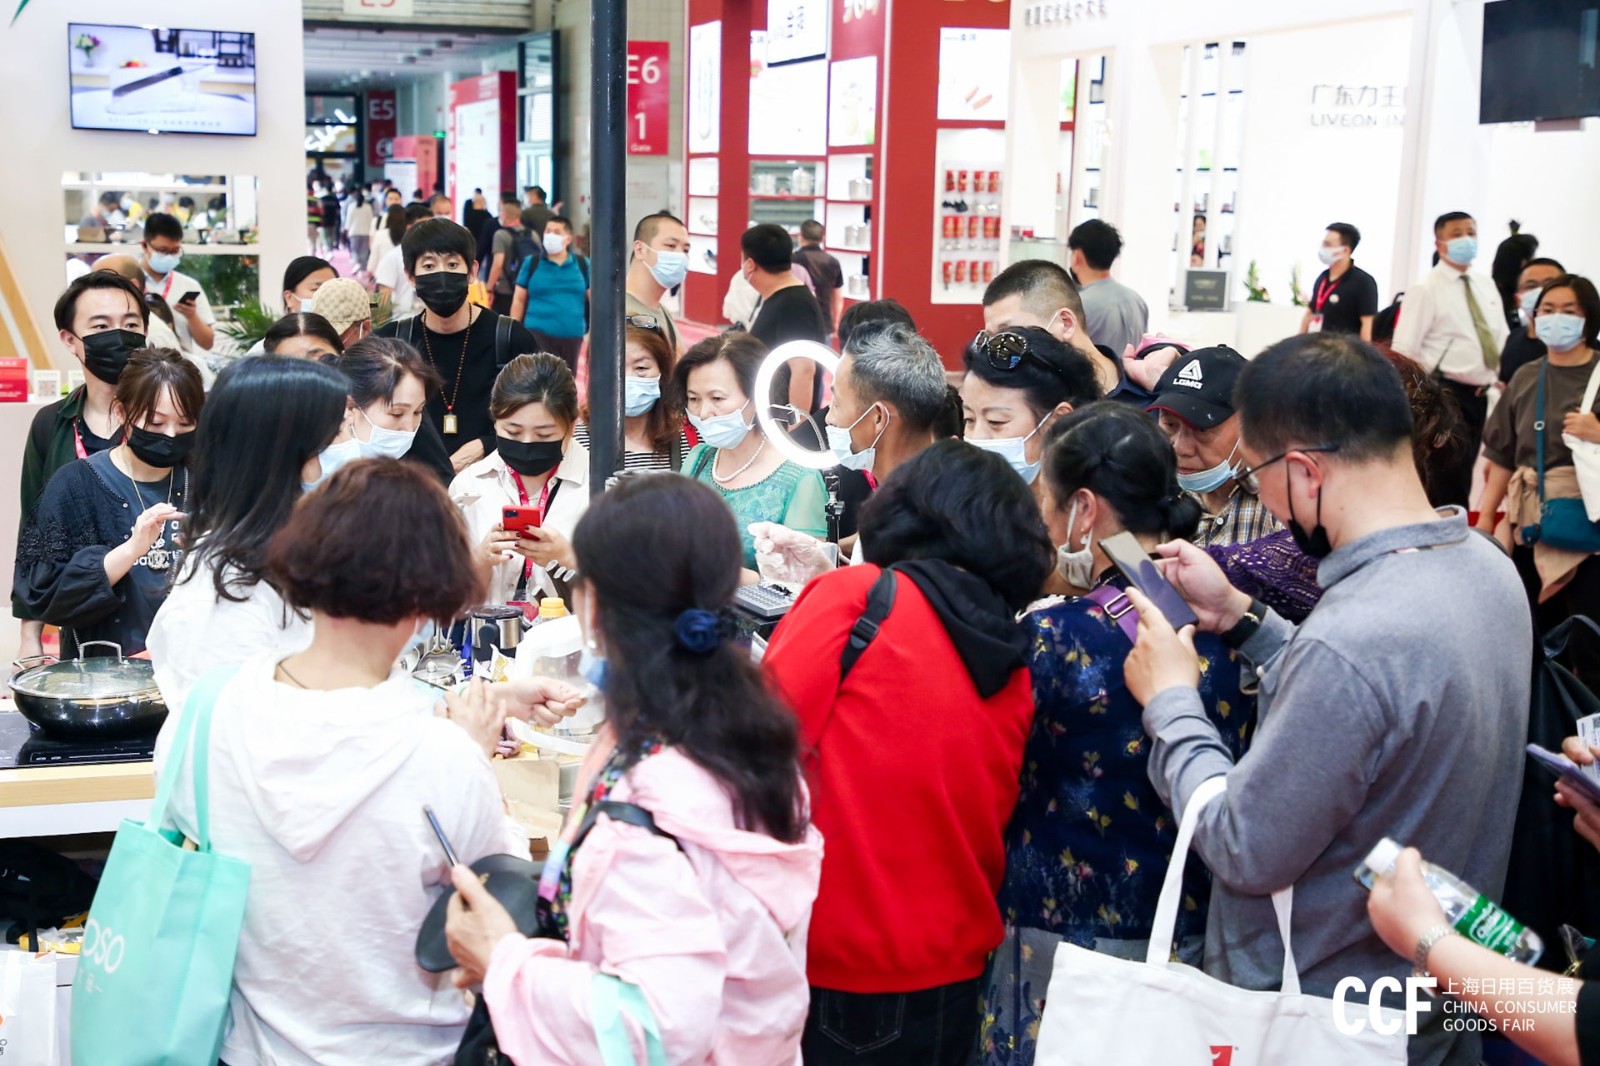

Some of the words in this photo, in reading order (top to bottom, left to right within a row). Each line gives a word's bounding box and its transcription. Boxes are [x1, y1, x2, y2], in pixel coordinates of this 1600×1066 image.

[627, 54, 661, 85] E6
[1311, 84, 1407, 108] 广东力王
[635, 112, 646, 140] 1
[1311, 113, 1377, 127] LIVEON
